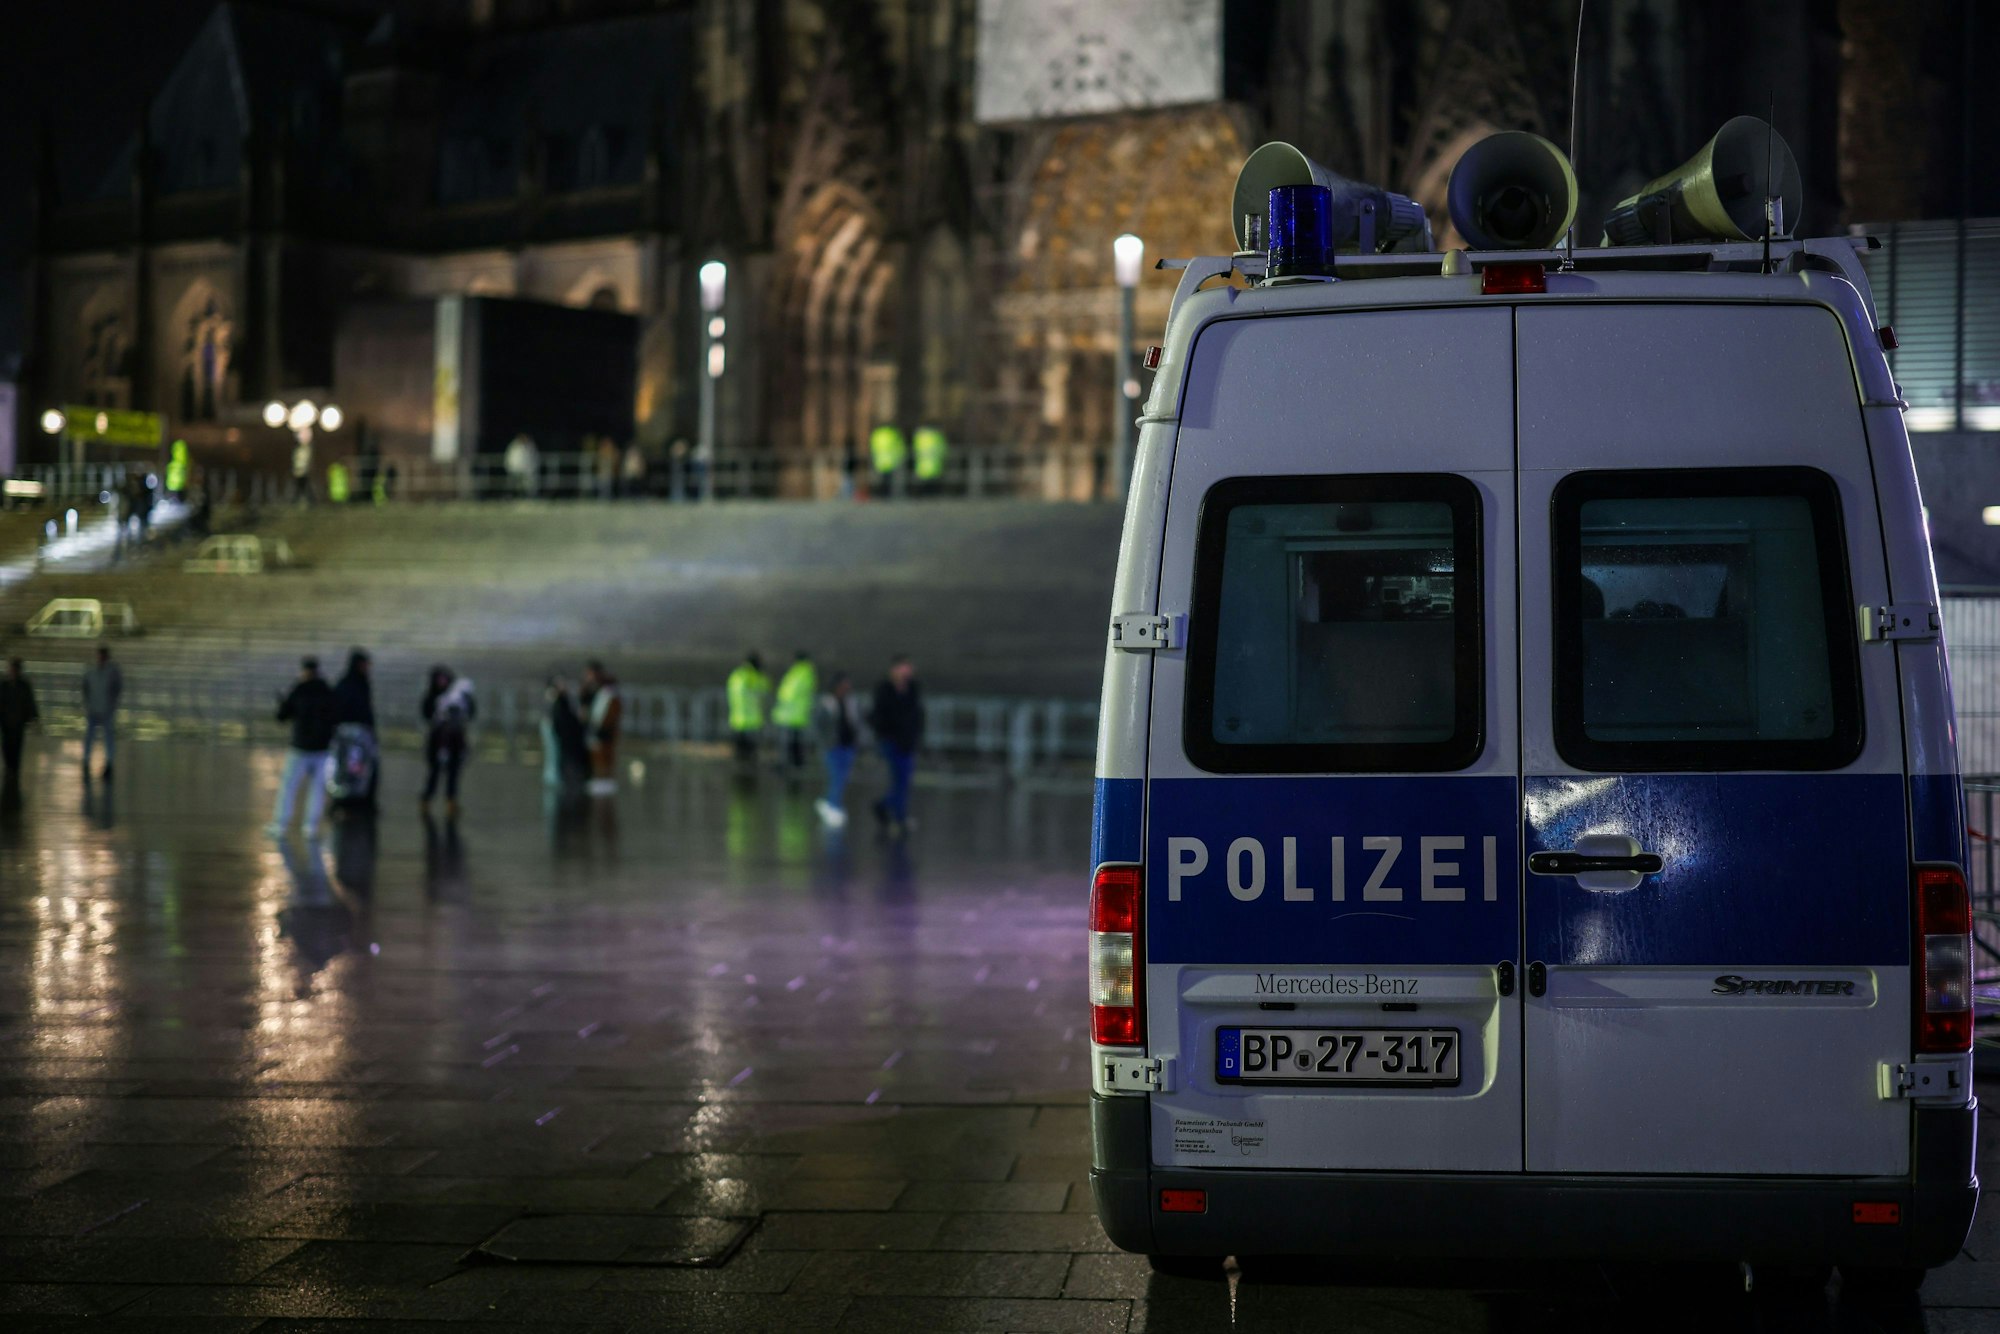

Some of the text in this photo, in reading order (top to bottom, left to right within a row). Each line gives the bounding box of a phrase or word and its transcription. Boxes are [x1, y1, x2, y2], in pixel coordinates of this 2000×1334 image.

[1168, 836, 1497, 901] POLIZEI
[1255, 973, 1418, 995] Mercedes-Benz
[1712, 975, 1855, 996] SPRINTER
[1225, 1058, 1233, 1068] D
[1242, 1035, 1453, 1073] BP 27-317
